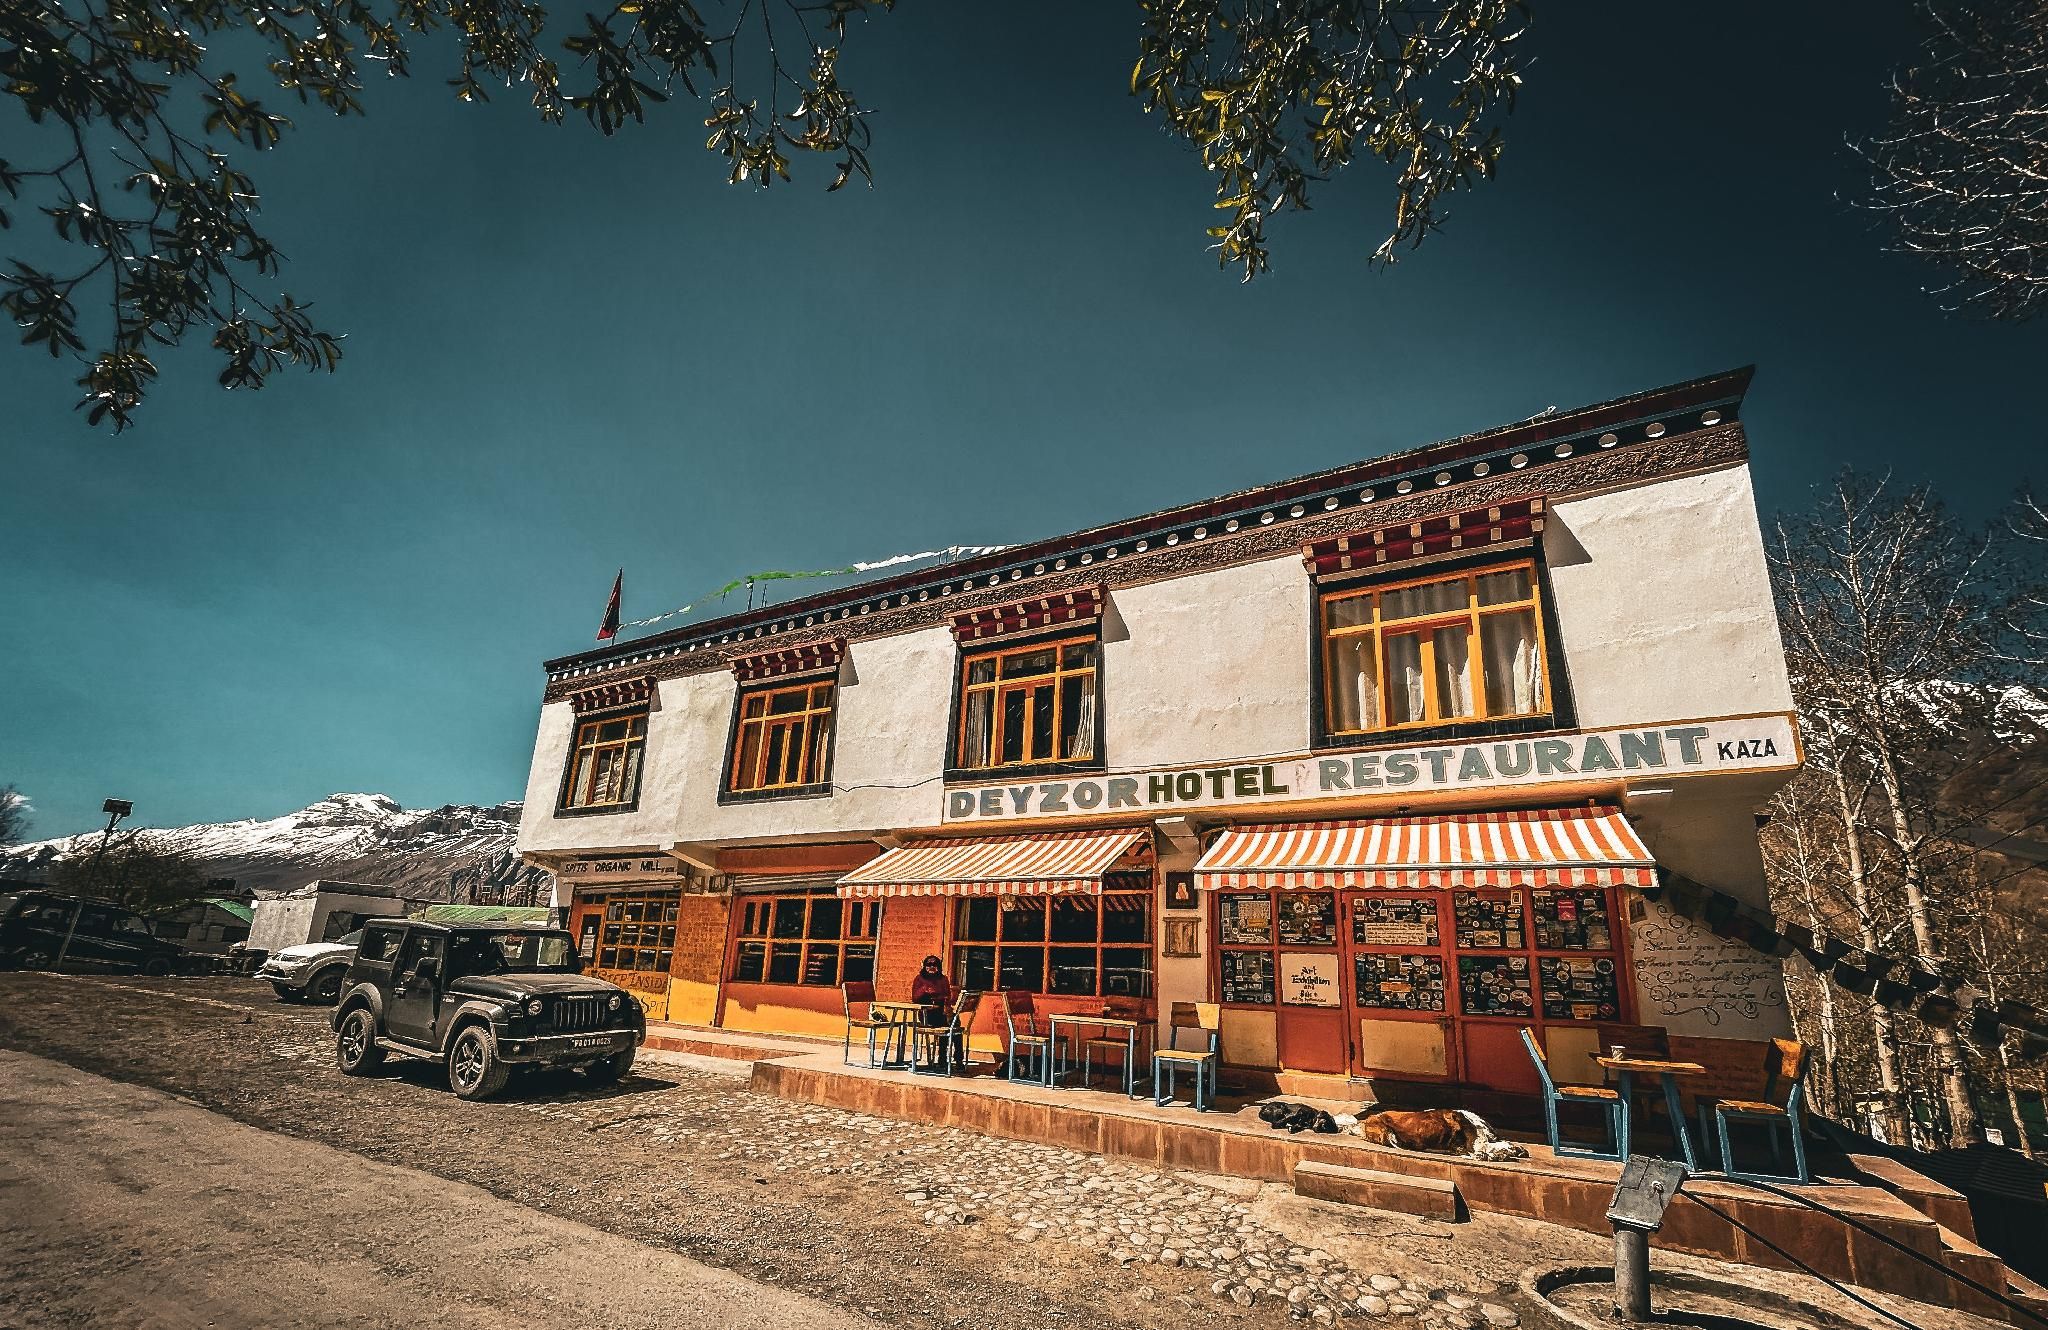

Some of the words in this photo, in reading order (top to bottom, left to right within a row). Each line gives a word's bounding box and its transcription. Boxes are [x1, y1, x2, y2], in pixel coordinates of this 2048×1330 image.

[949, 777, 1141, 819] DEYZOR
[1147, 765, 1290, 804] HOTEL
[1318, 727, 1709, 792] RESTAURANT
[1717, 737, 1779, 761] KAZA
[594, 861, 632, 873] ORGANIC
[640, 860, 660, 872] MILL
